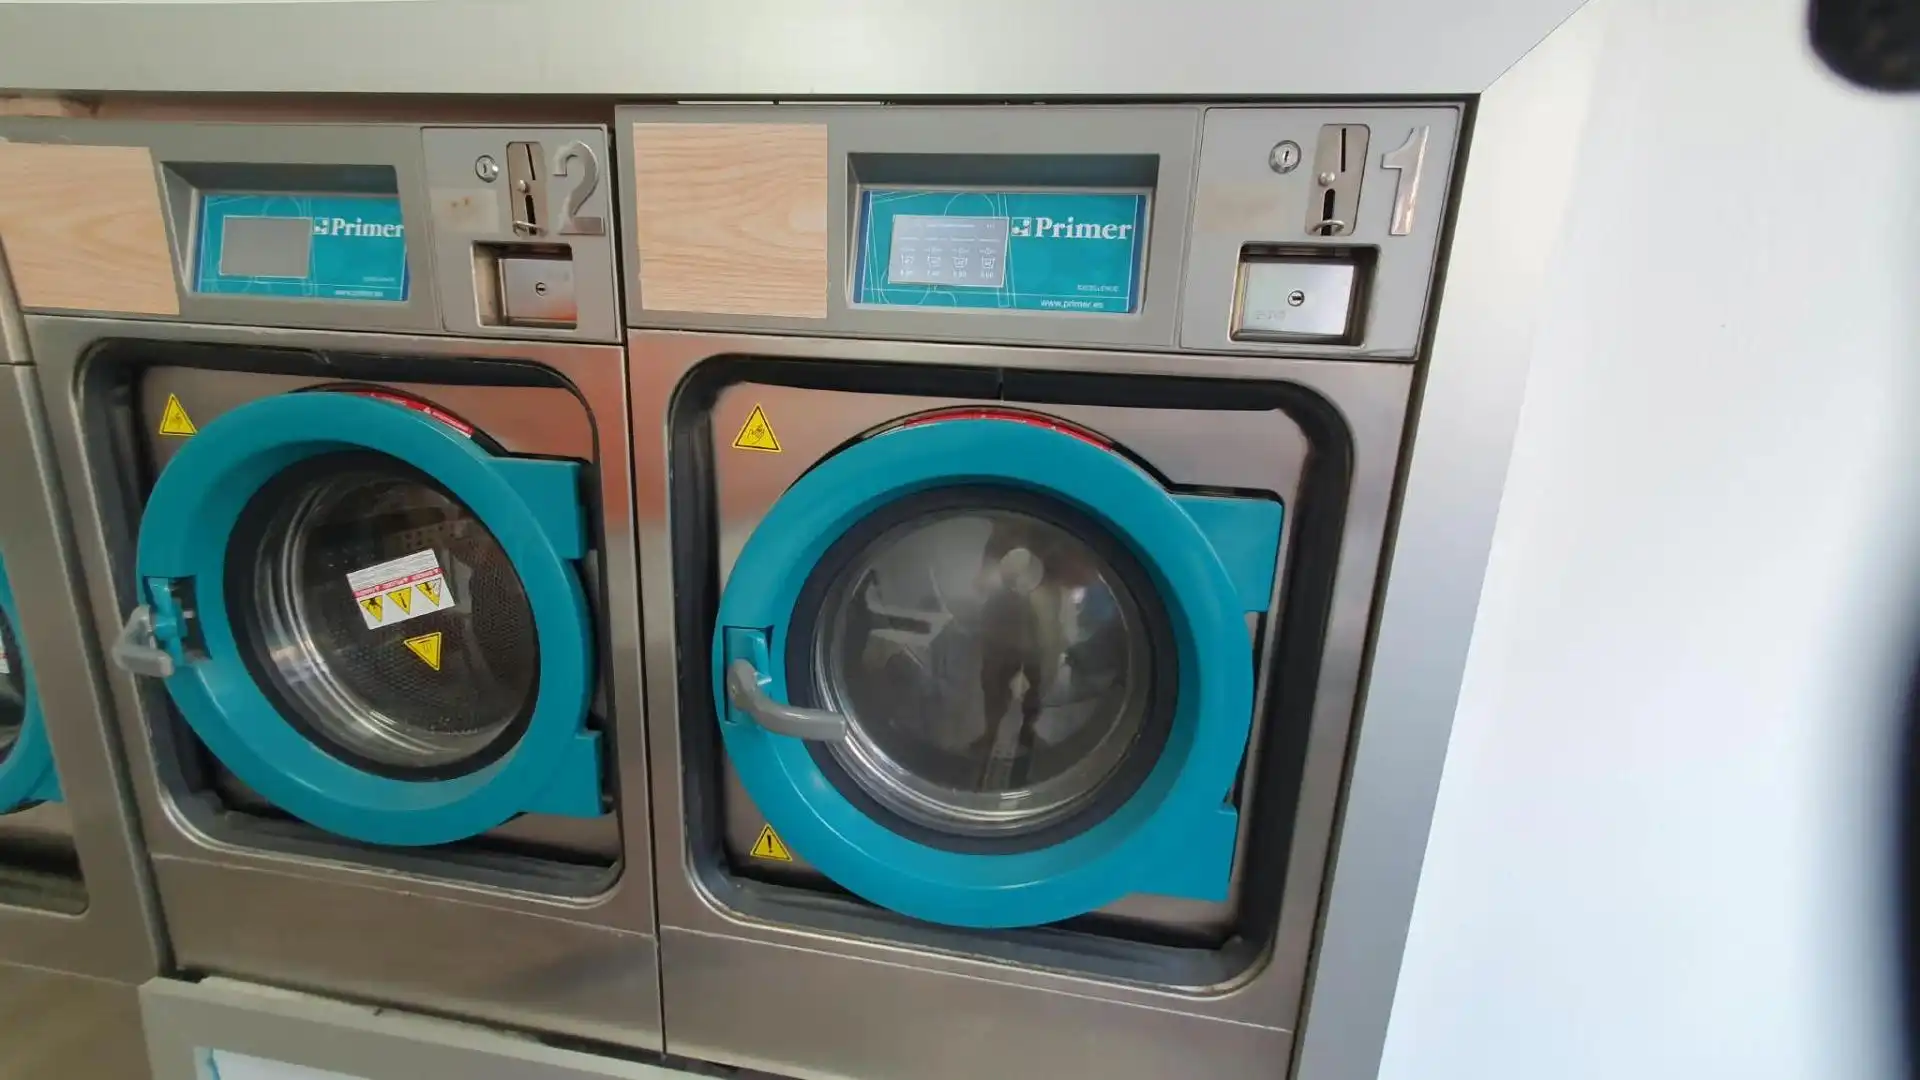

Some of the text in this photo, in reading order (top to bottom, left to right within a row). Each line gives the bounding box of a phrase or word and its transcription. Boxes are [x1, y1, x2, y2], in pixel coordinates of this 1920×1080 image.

[553, 141, 605, 235] 2
[1380, 125, 1430, 236] 1
[331, 217, 404, 238] Primer
[1035, 216, 1132, 239] Primer
